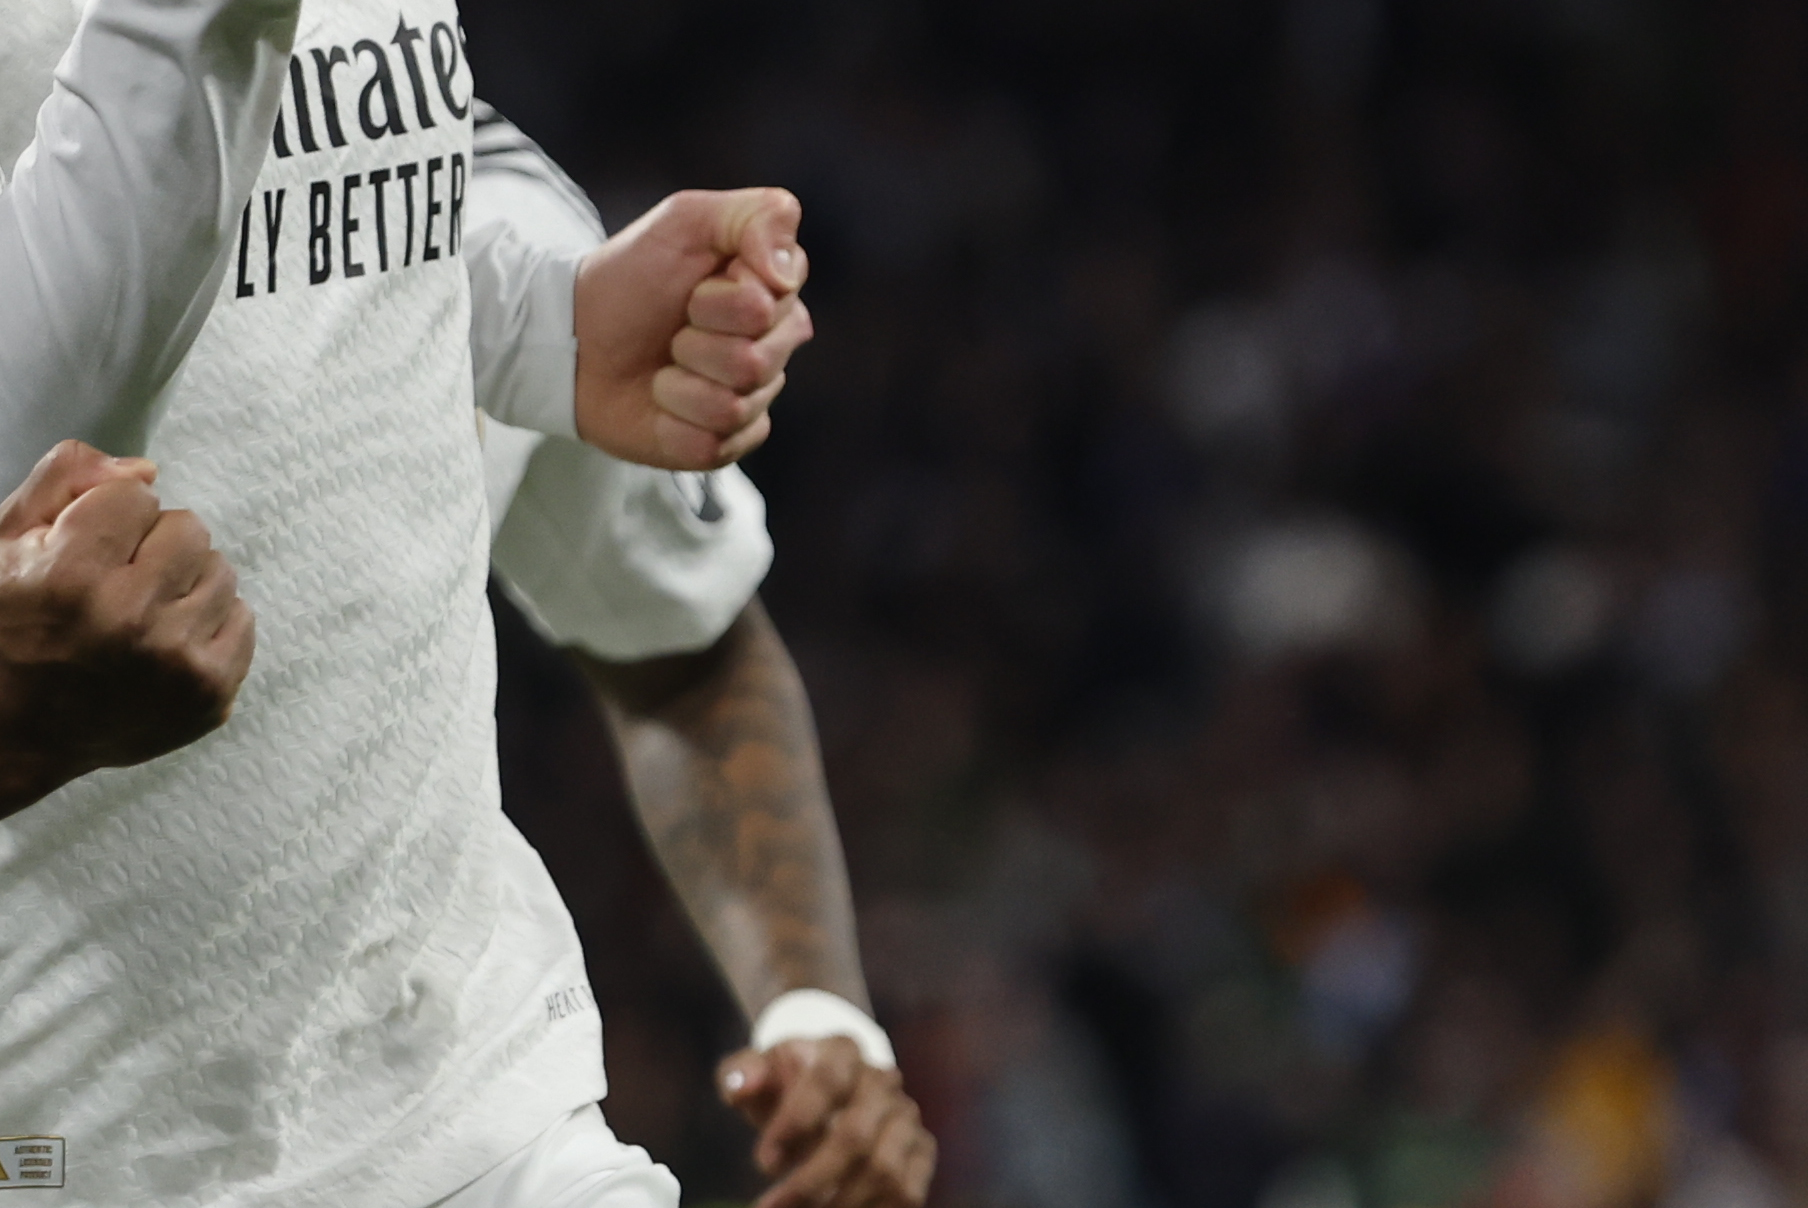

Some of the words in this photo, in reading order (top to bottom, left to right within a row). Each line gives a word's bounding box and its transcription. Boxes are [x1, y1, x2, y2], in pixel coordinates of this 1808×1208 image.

[273, 9, 467, 159] irate
[236, 188, 286, 299] LY
[309, 152, 465, 286] BETTER
